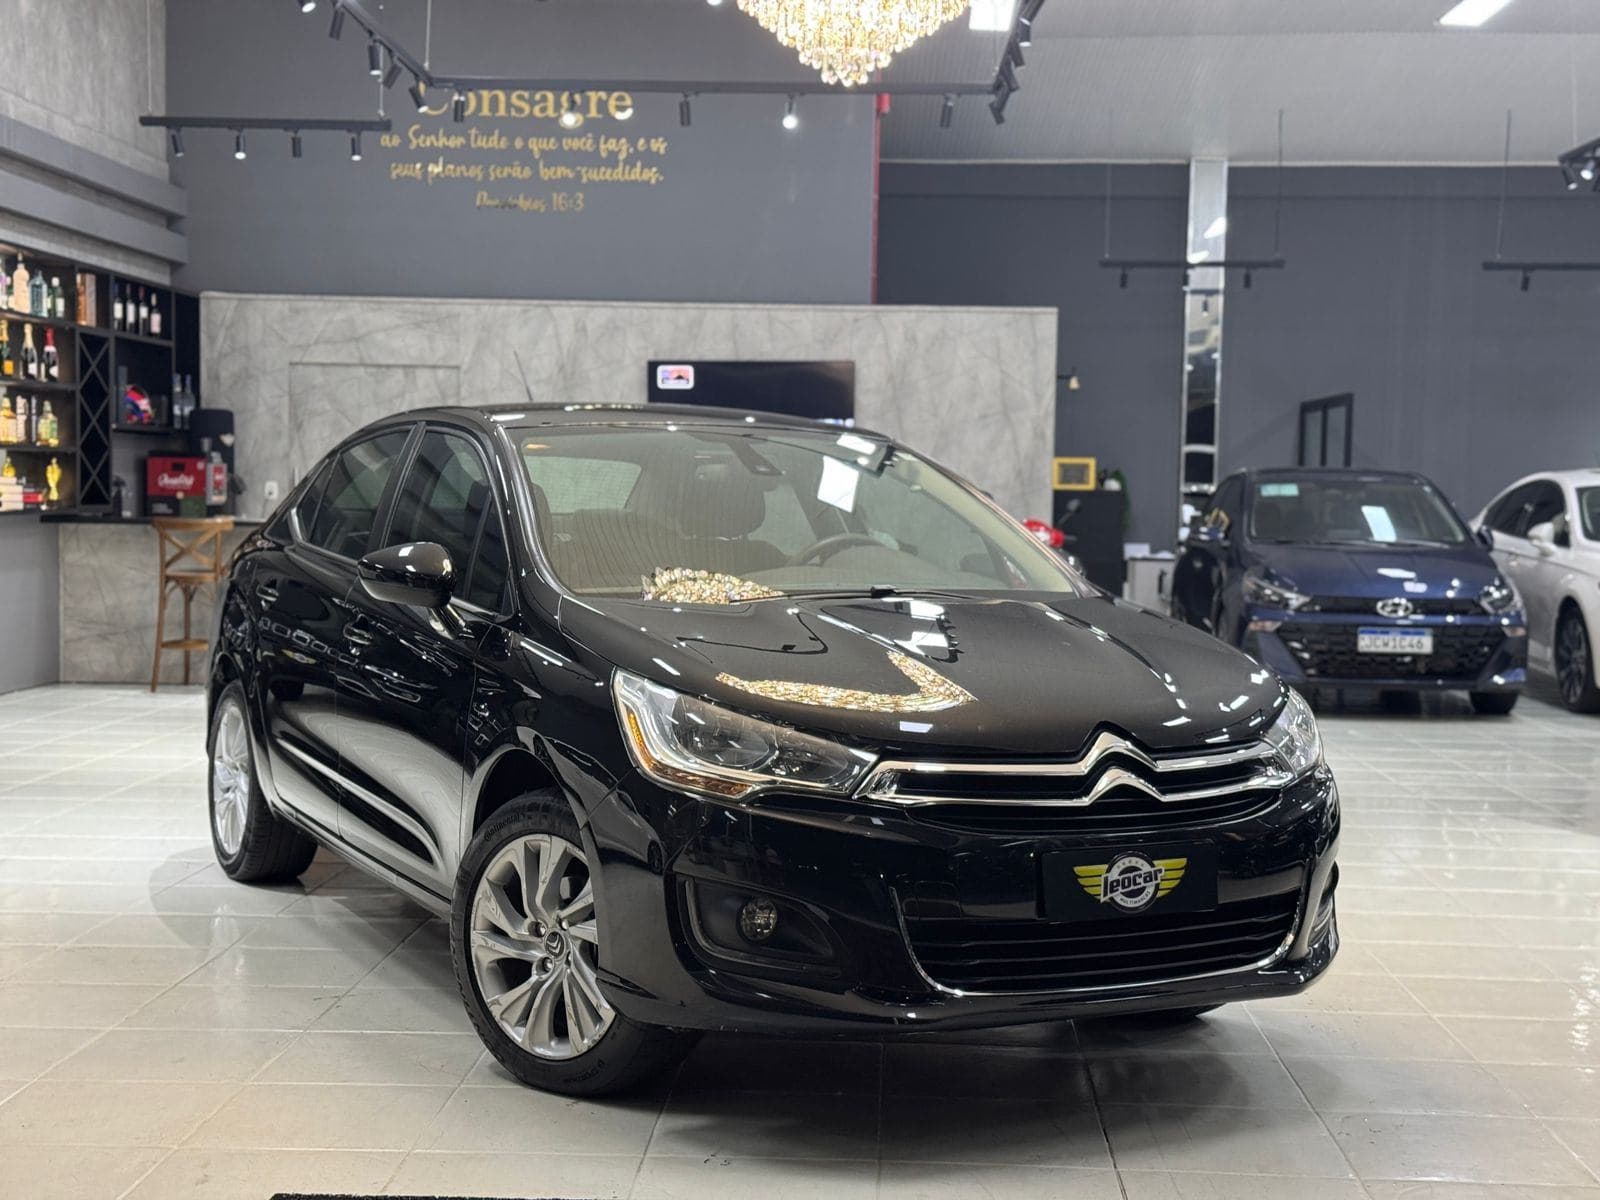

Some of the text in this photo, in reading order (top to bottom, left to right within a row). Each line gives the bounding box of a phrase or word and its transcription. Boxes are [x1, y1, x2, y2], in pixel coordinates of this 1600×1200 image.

[380, 134, 402, 148] ao
[408, 124, 466, 150] Senhor
[514, 135, 524, 148] o
[528, 134, 558, 159] que
[637, 137, 647, 150] e
[390, 162, 423, 181] seus
[427, 156, 484, 185] planos
[489, 160, 533, 181] serão
[552, 192, 585, 212] 16:3
